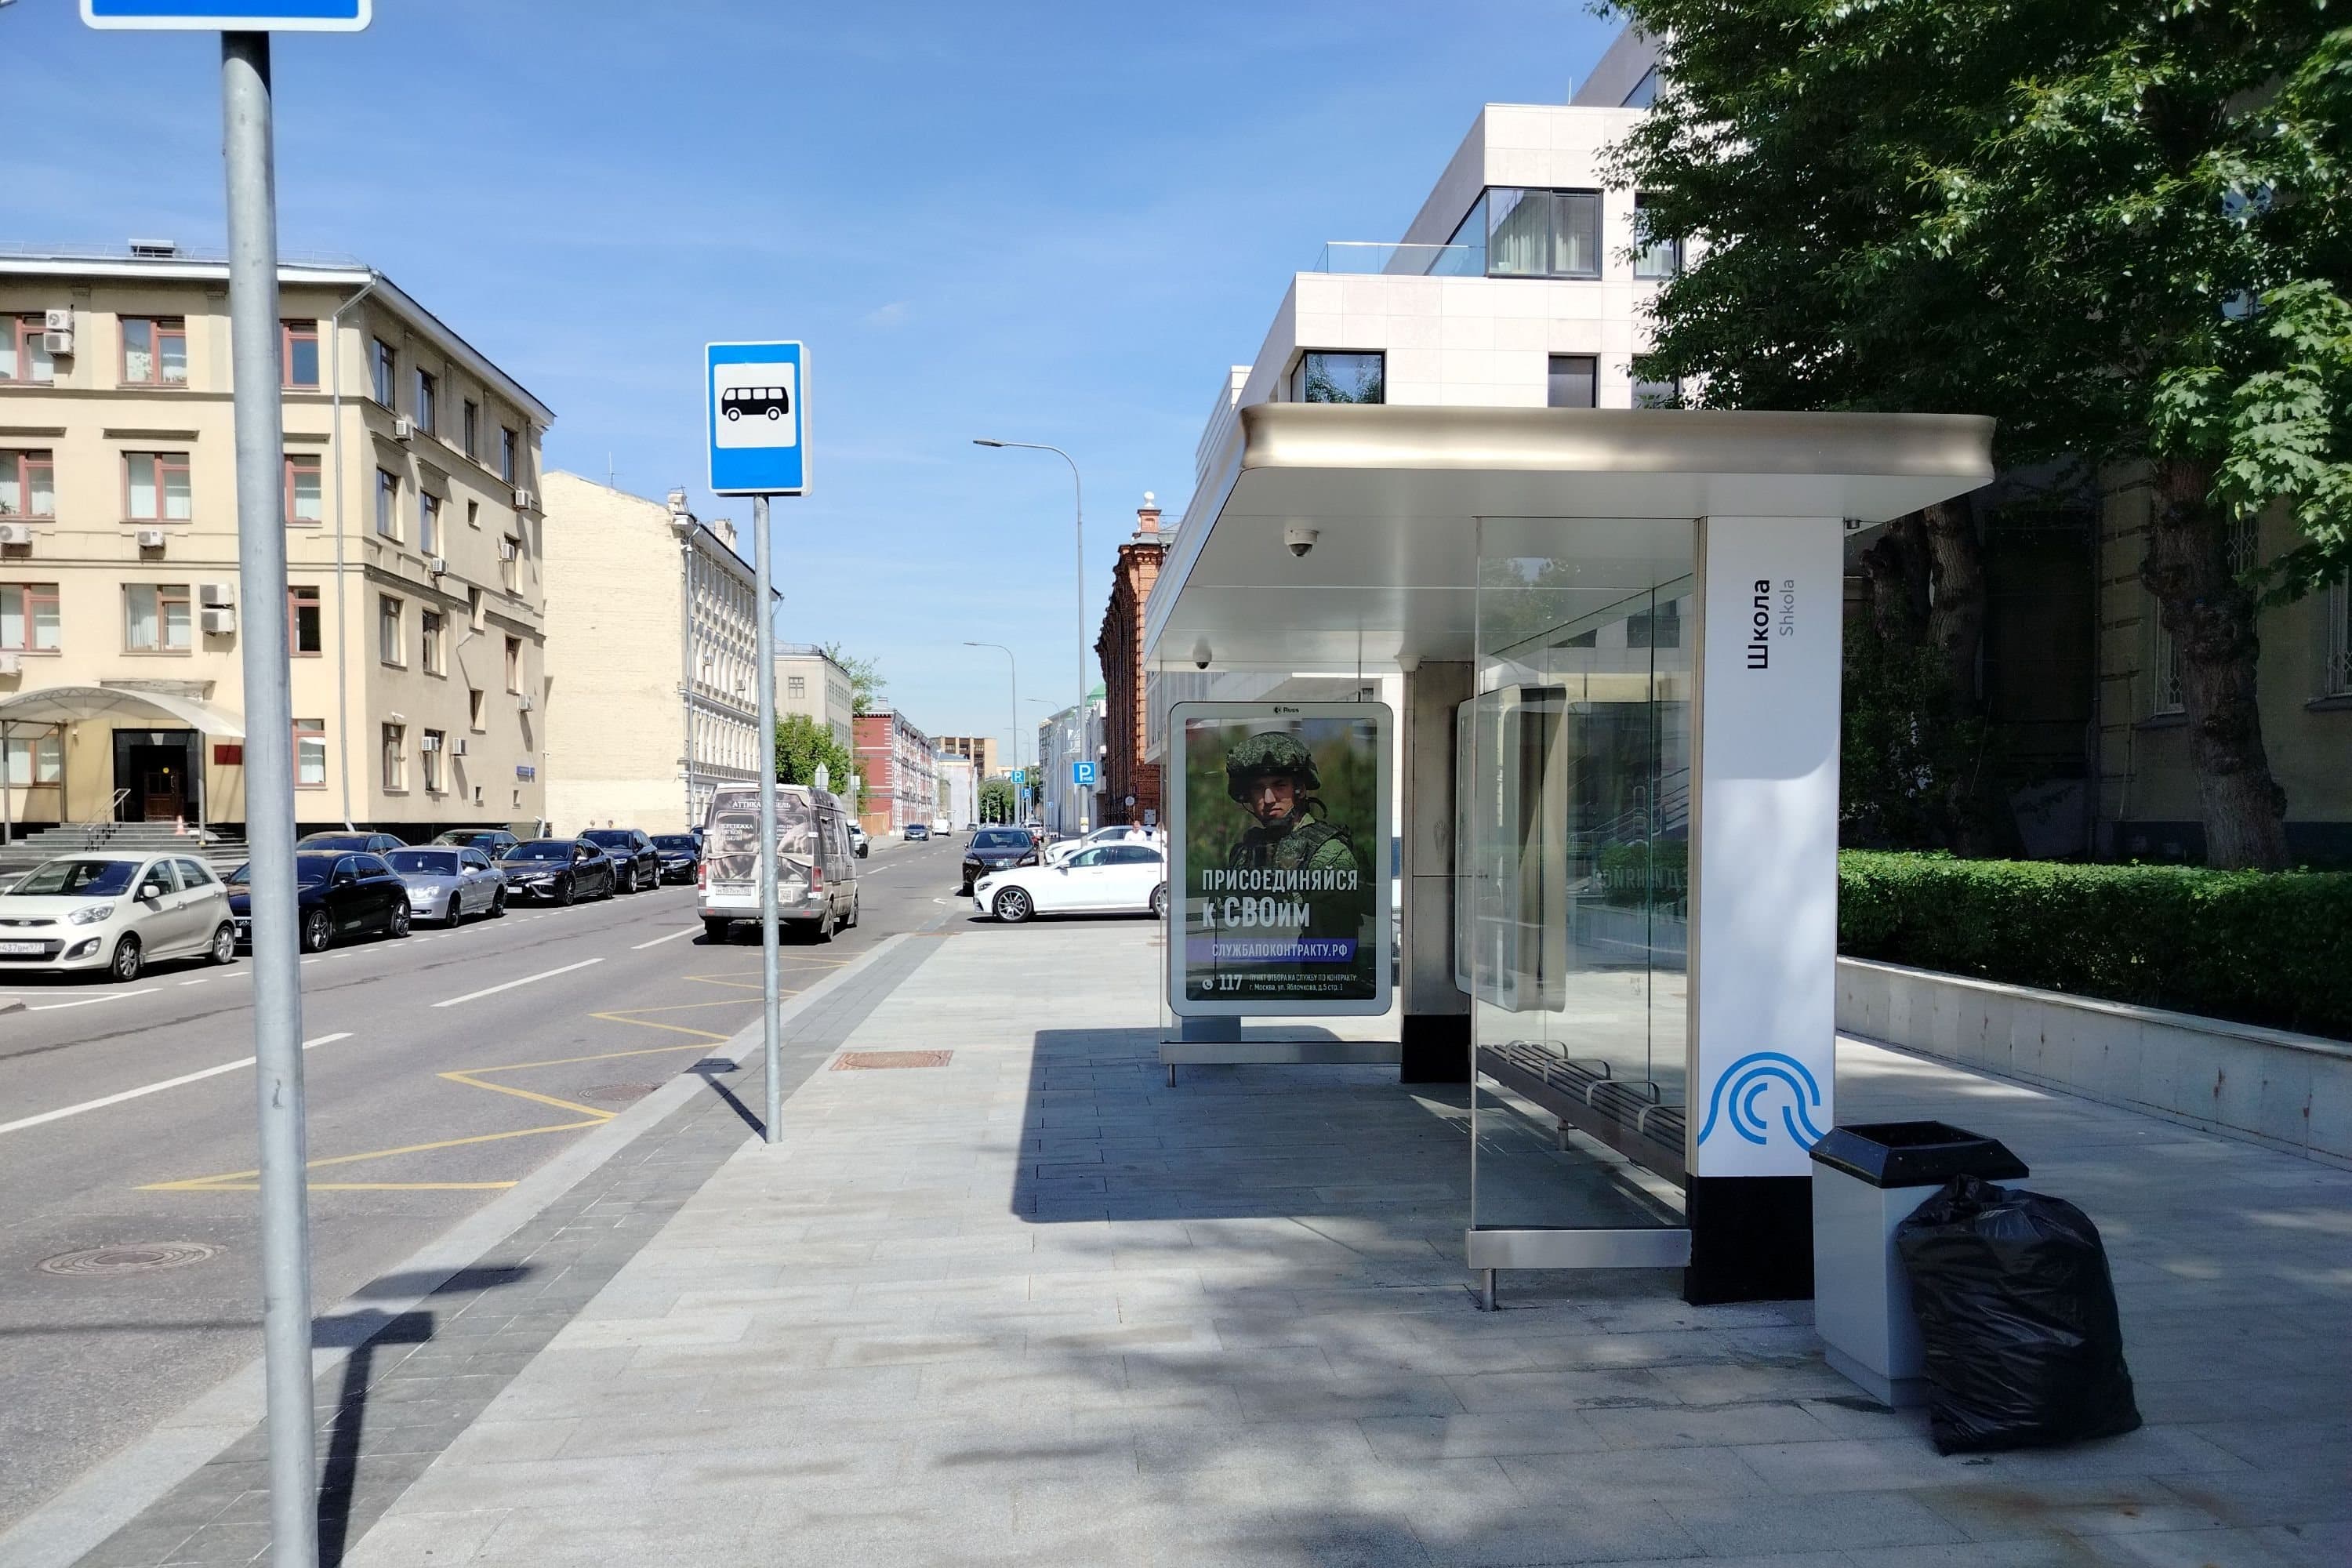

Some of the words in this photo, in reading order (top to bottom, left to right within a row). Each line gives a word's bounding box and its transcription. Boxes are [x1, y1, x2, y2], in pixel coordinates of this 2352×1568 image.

[1779, 579, 1794, 636] Shkola
[1748, 580, 1769, 669] Школа
[1203, 866, 1357, 892] ПРИСОЕДИНЯЙСЯ
[1225, 896, 1310, 927] СВОим
[1212, 943, 1348, 957] СЛУЖБАПОКОНТРАКТУ.РФ
[1219, 975, 1243, 990] 117
